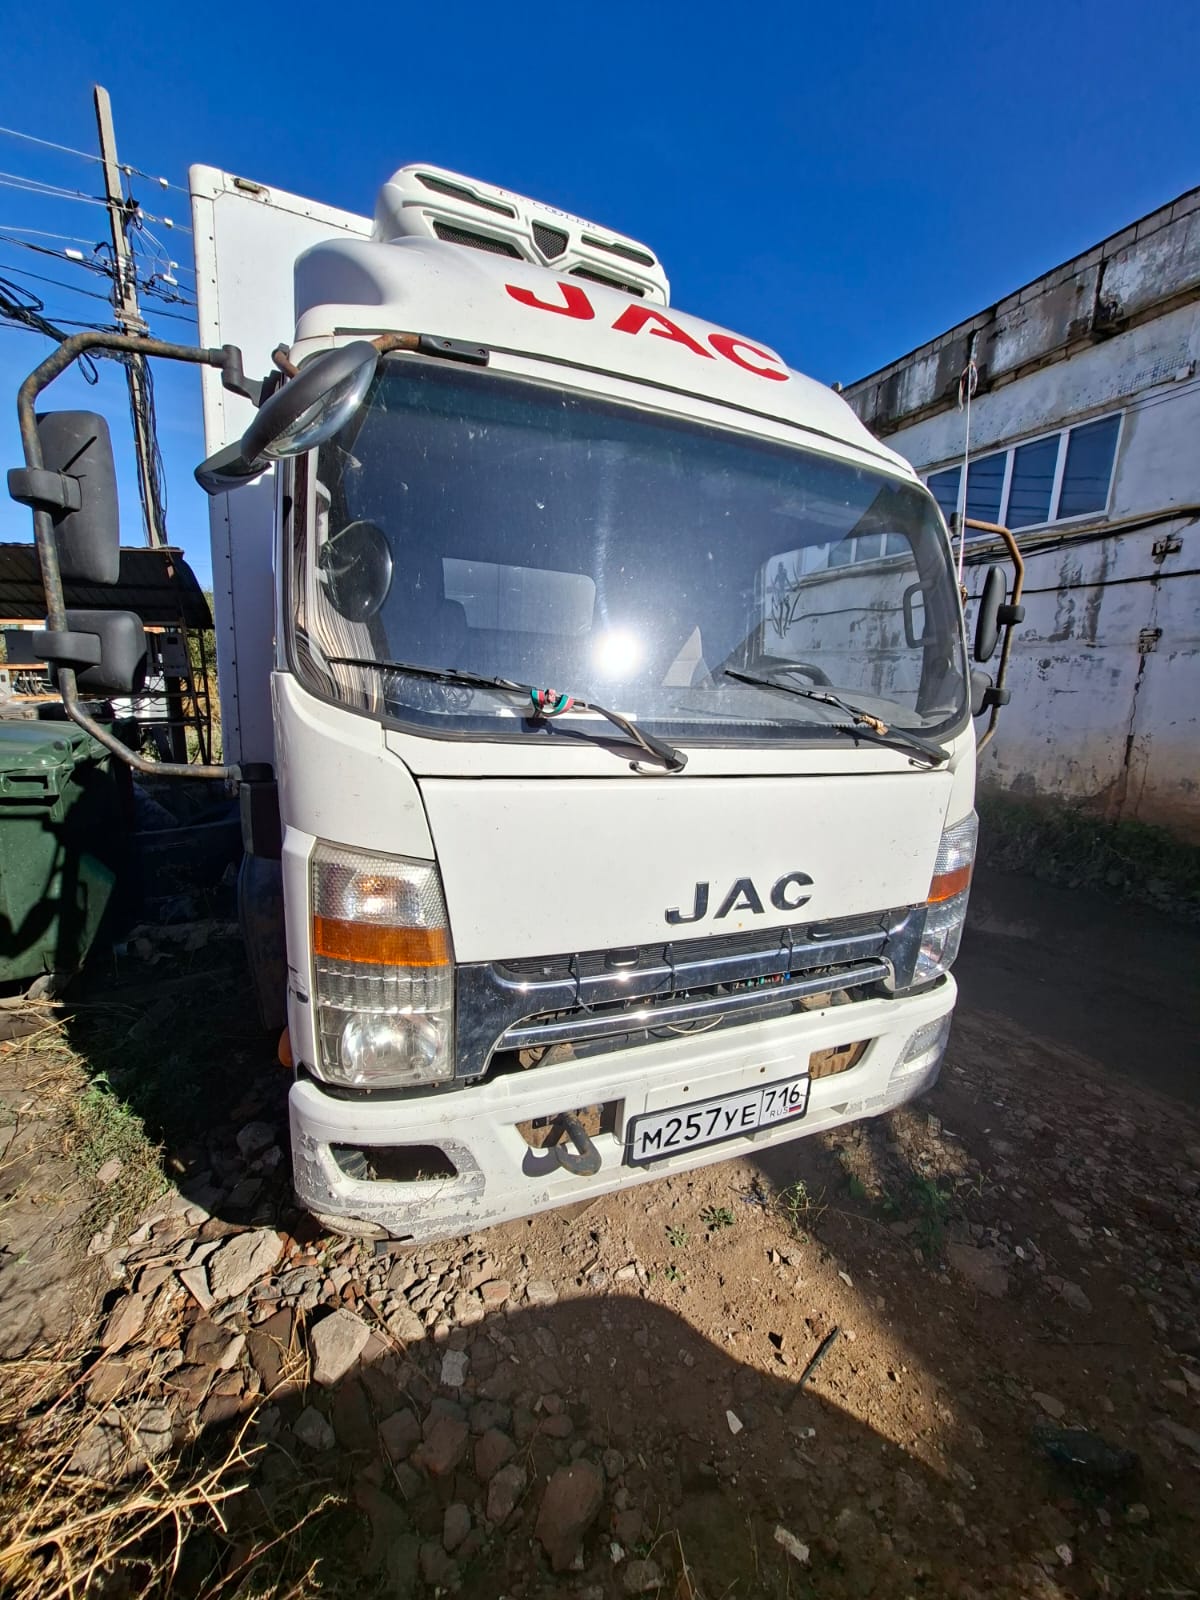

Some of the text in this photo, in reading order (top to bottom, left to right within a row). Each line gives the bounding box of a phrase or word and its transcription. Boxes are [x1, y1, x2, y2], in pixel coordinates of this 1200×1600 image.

[505, 281, 790, 381] JAC
[665, 871, 814, 925] JAC
[764, 1083, 800, 1113] 716
[770, 1106, 789, 1119] RUS
